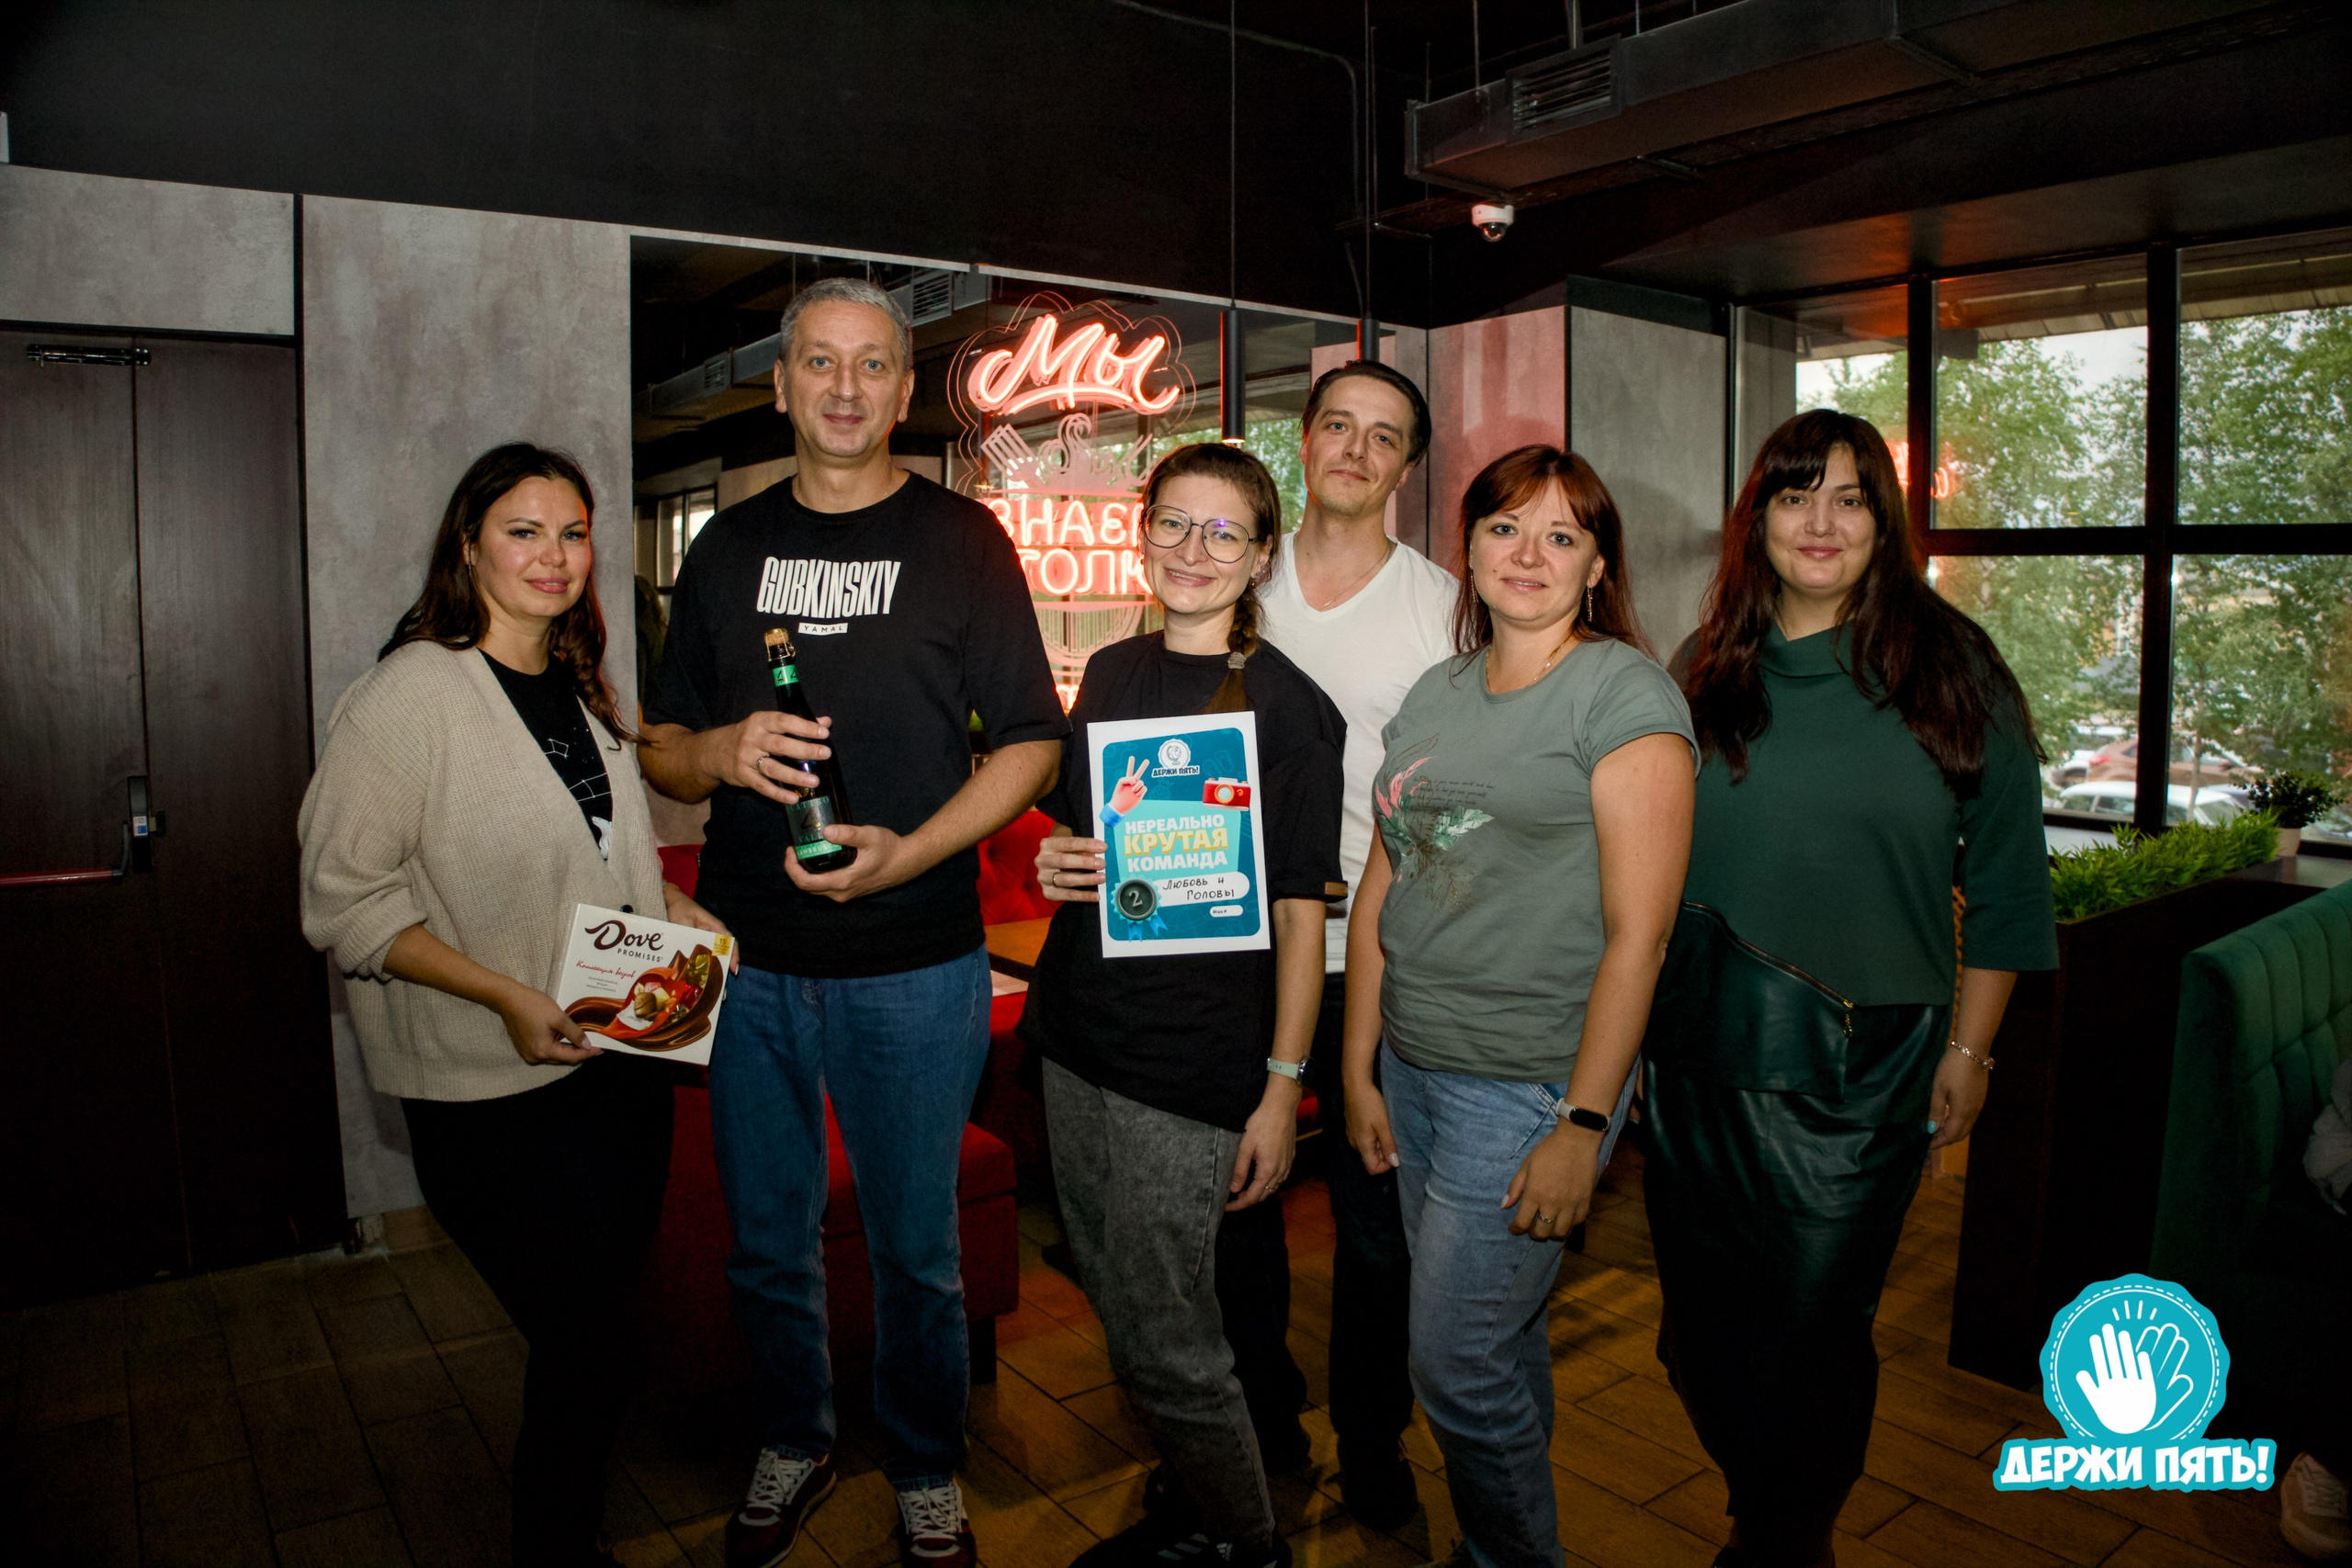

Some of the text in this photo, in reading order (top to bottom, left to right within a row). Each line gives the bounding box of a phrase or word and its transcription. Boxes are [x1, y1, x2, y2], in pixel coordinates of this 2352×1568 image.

[995, 497, 1146, 547] ЗНАЕ
[756, 556, 902, 619] GUBKINSKIY
[803, 625, 843, 634] YAMAL
[1152, 766, 1199, 777] ДЕРЖИ ПЯТЬ!
[1125, 814, 1225, 835] НЕРЕАЛЬНО
[1124, 828, 1228, 856] КРУТАЯ
[1127, 851, 1228, 873] КОМАНДА
[1128, 889, 1143, 908] 2
[617, 948, 662, 963] PROMISES
